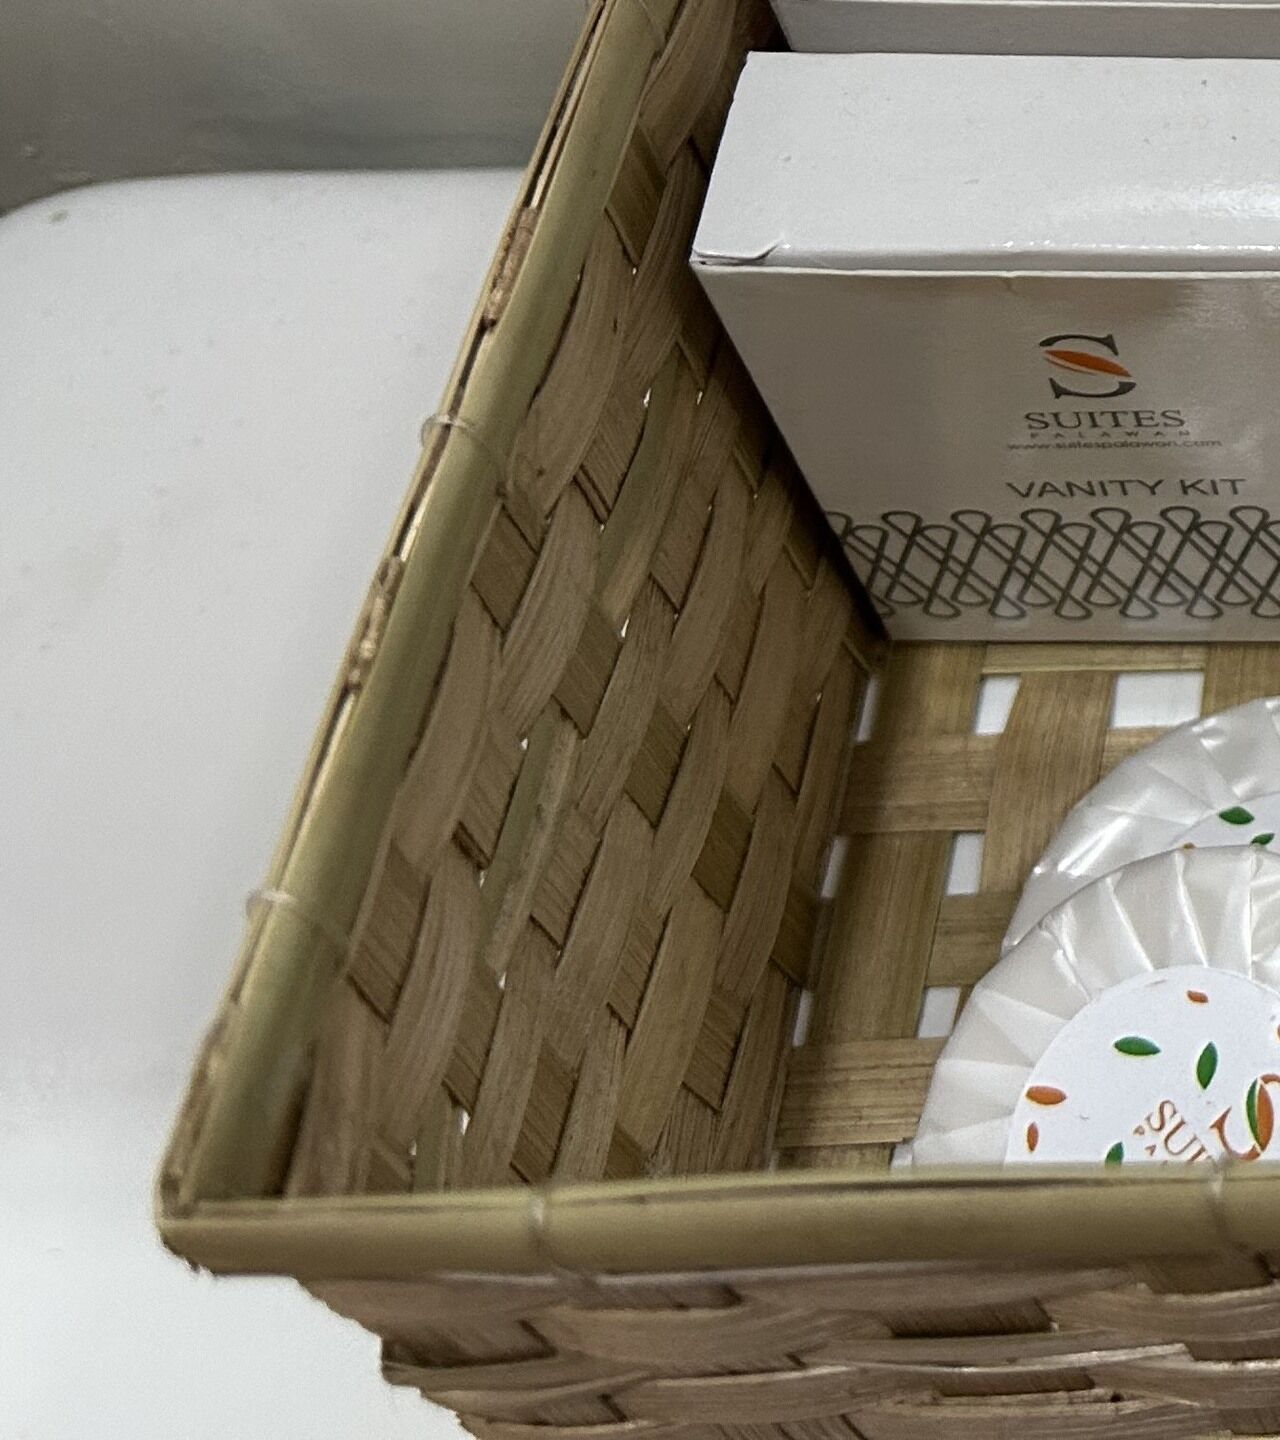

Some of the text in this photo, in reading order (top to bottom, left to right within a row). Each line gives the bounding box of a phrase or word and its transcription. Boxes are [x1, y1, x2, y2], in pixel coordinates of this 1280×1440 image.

[1024, 409, 1186, 430] SUITES
[1006, 478, 1248, 499] VANITY KIT
